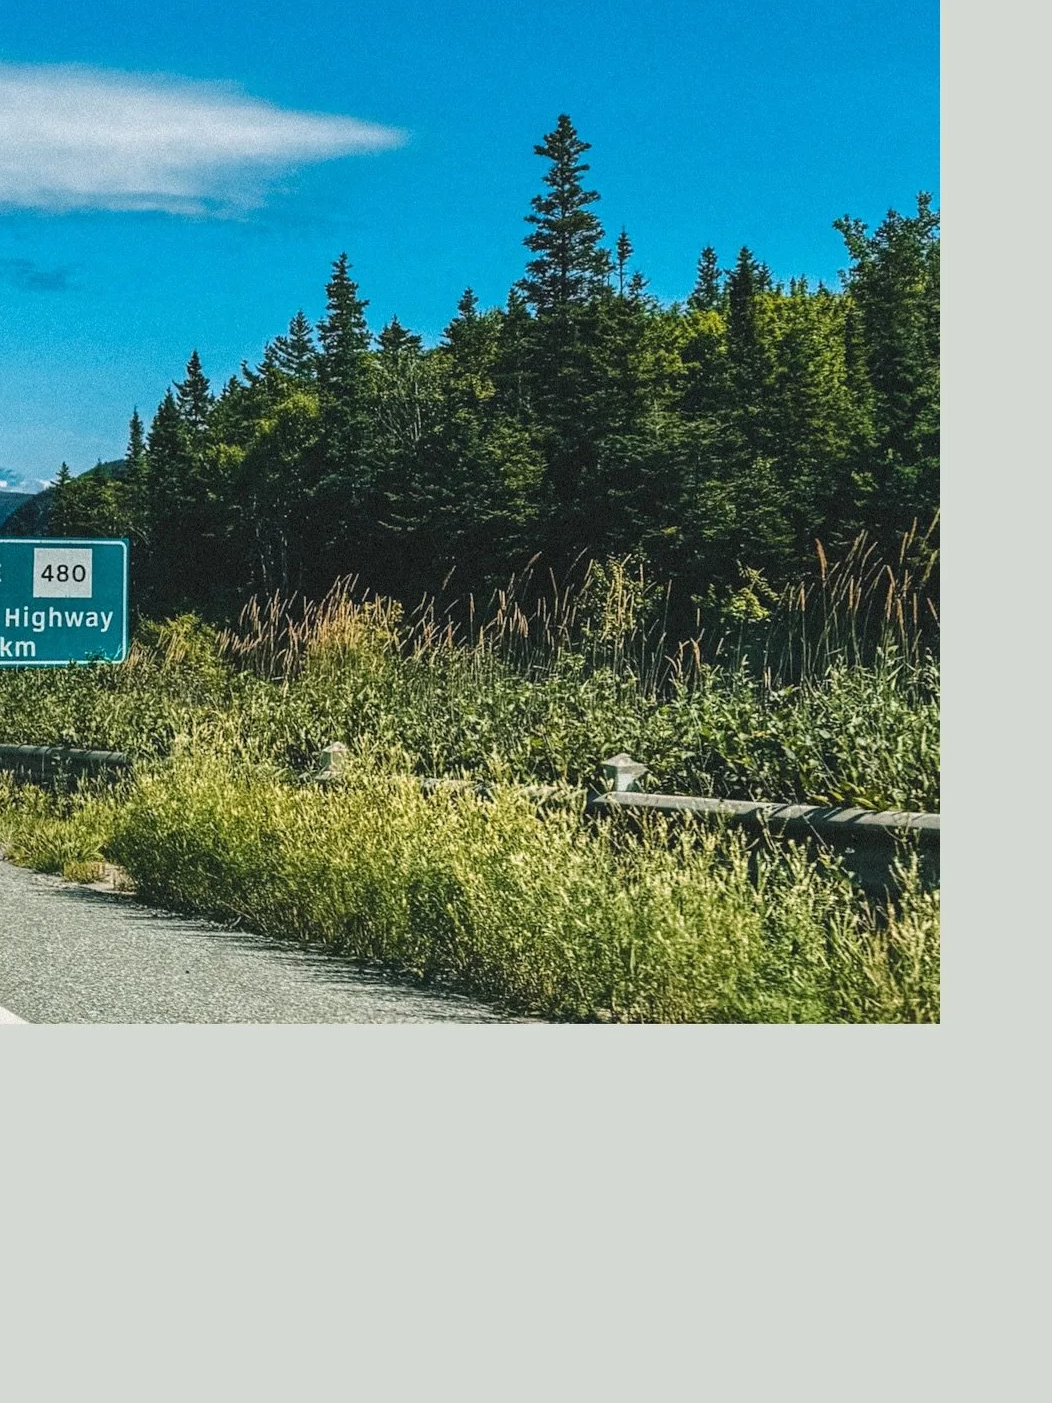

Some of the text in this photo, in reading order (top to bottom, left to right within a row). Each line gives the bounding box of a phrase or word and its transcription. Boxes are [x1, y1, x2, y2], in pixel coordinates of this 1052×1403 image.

[40, 564, 87, 582] 480
[4, 605, 114, 633] Highway
[0, 636, 36, 658] km
